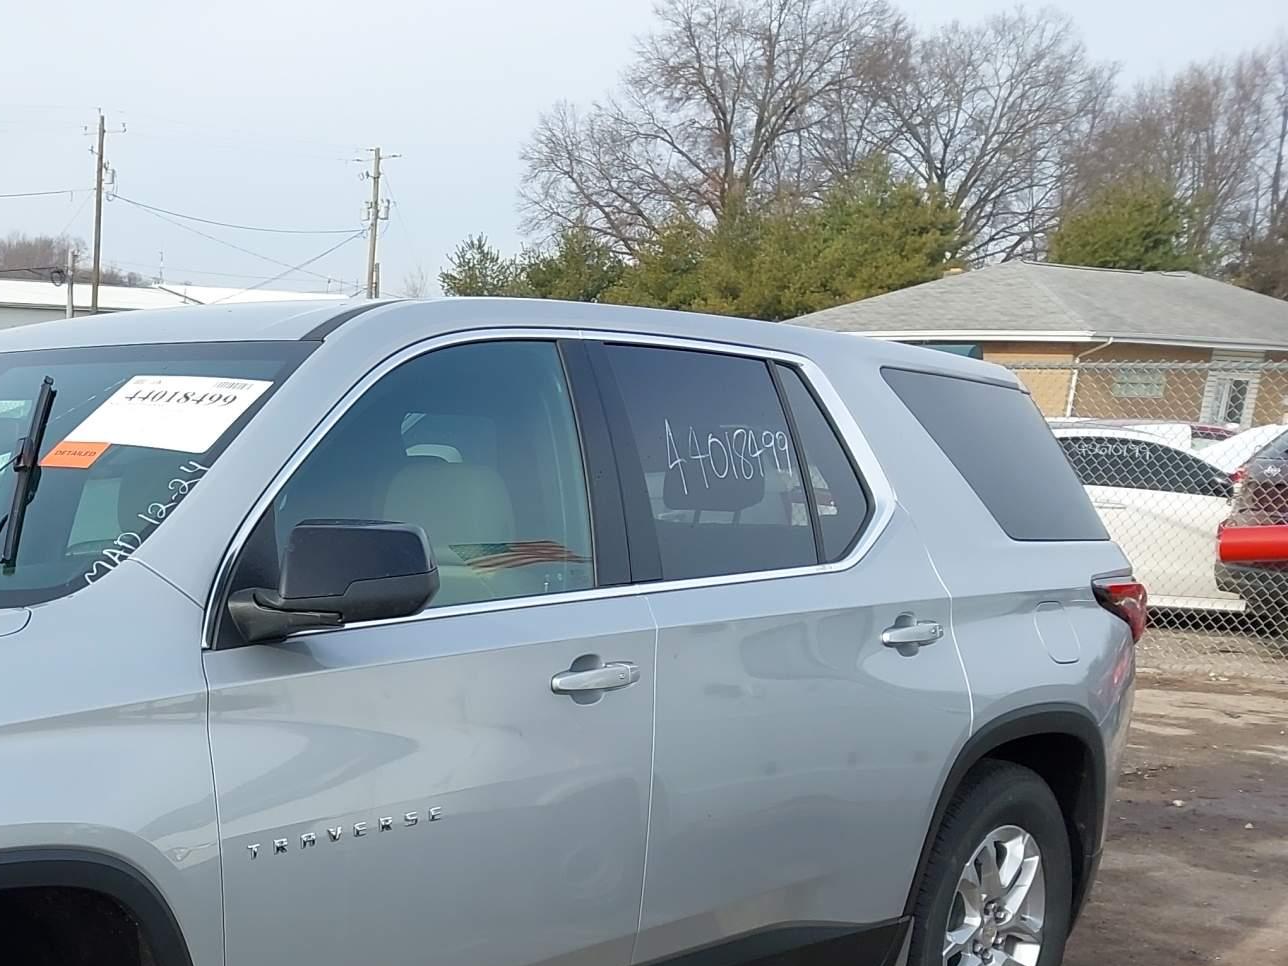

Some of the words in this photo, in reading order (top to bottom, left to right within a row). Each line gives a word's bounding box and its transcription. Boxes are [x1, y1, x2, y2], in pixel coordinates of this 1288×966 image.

[124, 389, 238, 408] 44018499
[665, 418, 793, 495] 44018499
[84, 532, 142, 585] MAD
[247, 806, 442, 860] TRAVERSE
